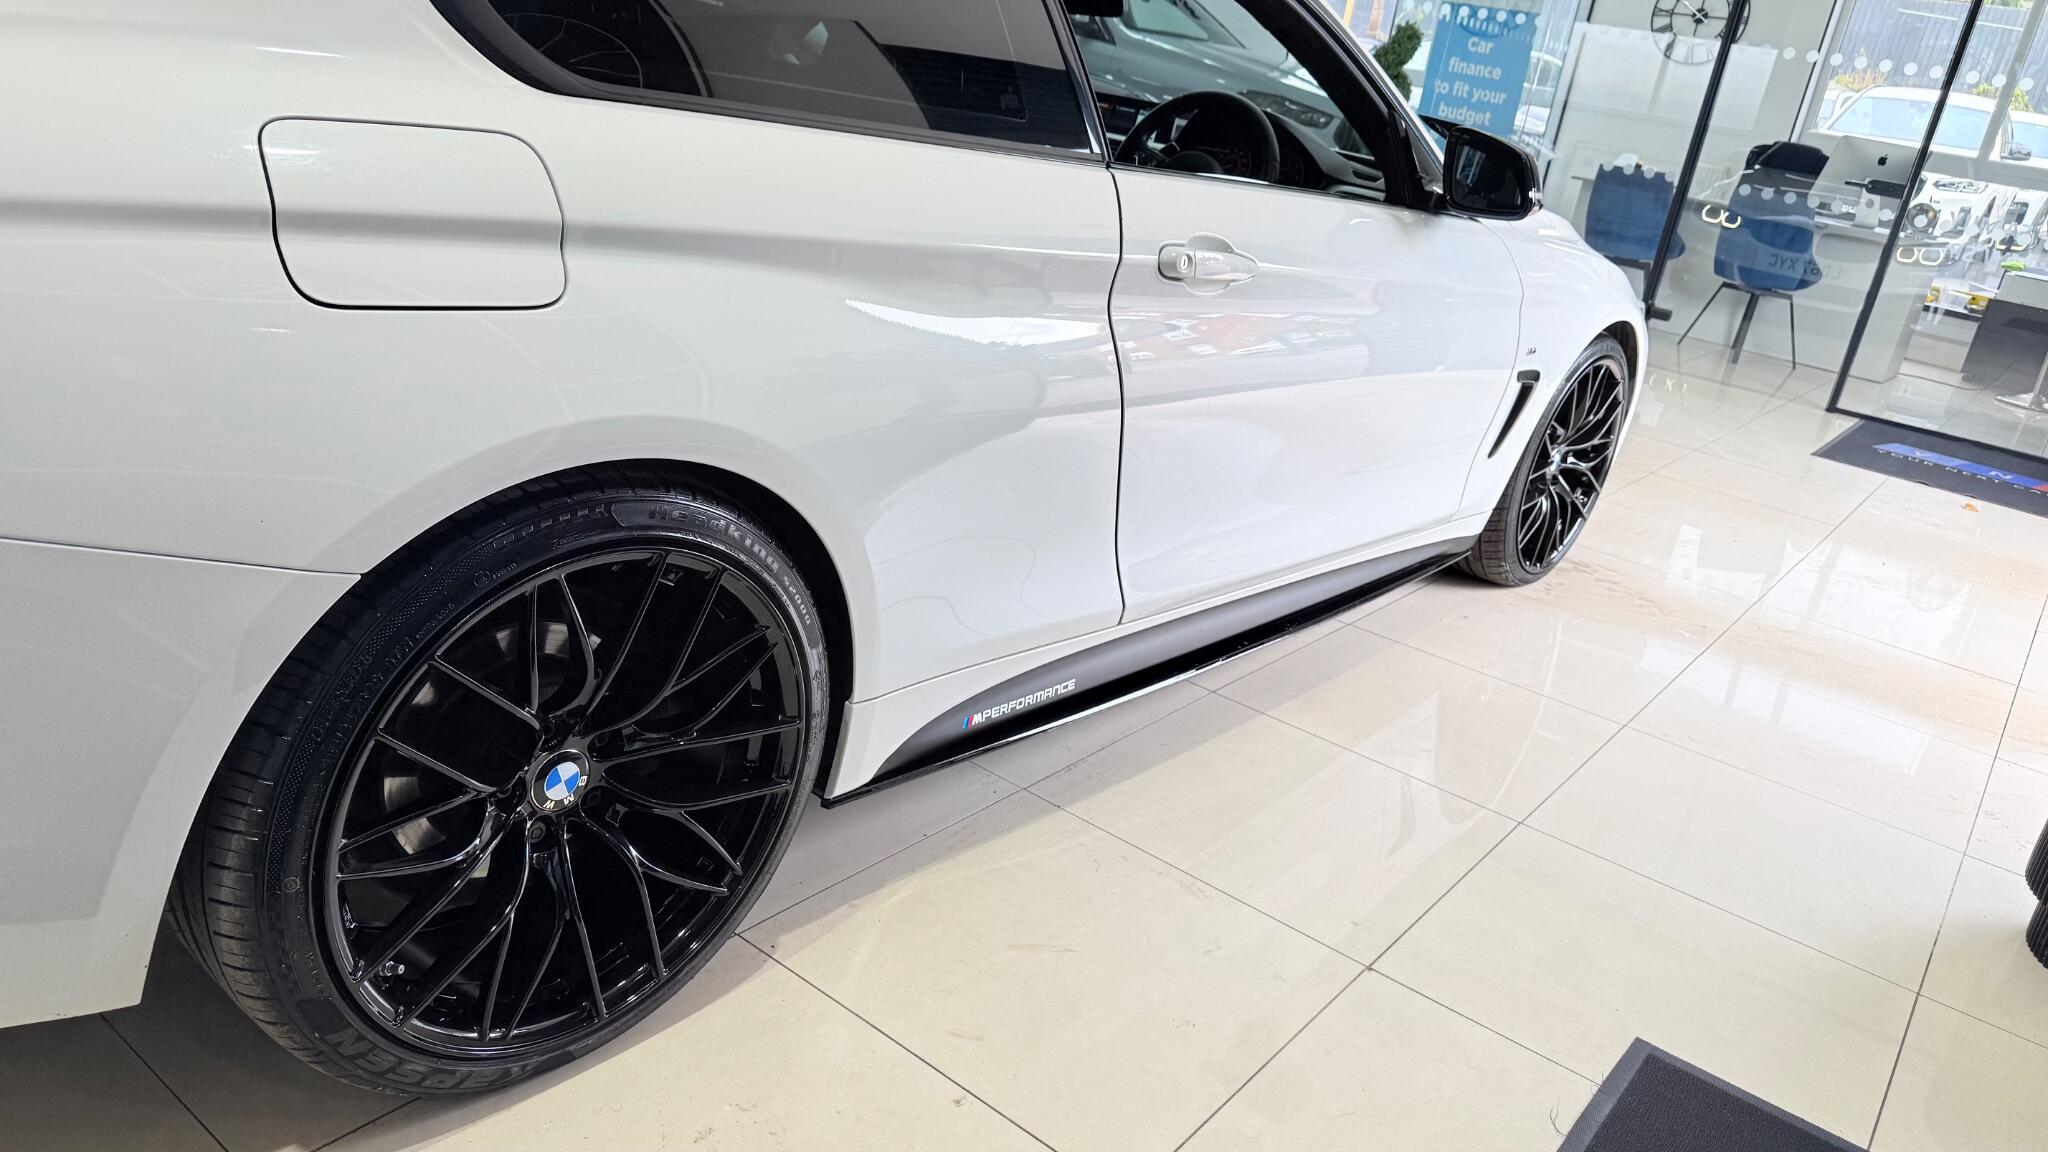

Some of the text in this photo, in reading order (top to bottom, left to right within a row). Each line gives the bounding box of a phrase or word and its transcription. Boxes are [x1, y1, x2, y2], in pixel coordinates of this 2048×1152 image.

[1467, 36, 1495, 55] Car
[1448, 56, 1502, 80] finance
[1434, 79, 1507, 105] to fit your
[1438, 101, 1492, 126] budget
[1946, 467, 2000, 484] NEXT
[2013, 484, 2048, 497] CA
